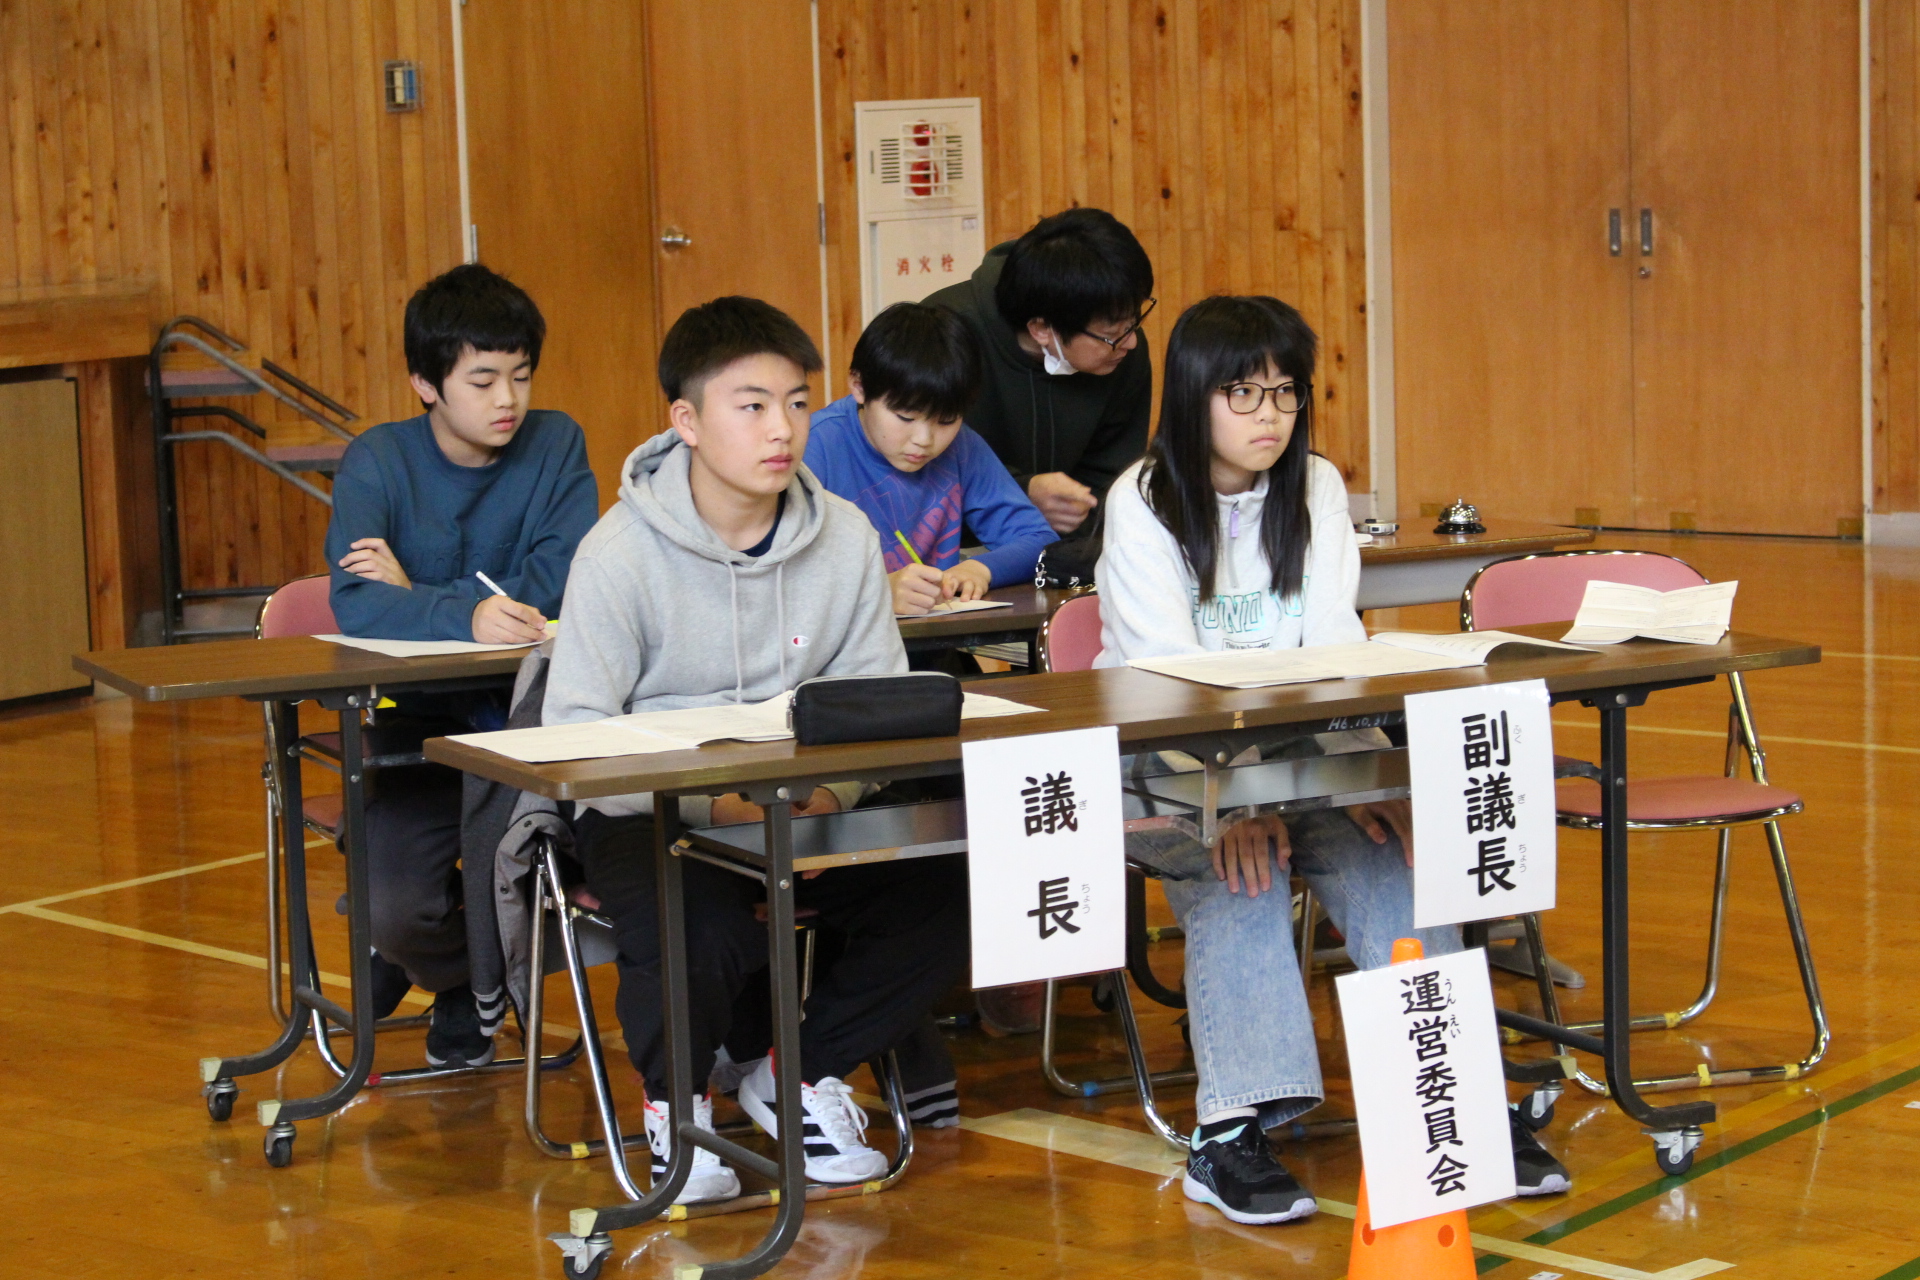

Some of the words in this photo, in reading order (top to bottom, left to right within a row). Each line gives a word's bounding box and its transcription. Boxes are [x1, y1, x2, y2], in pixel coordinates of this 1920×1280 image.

[896, 253, 954, 276] 消火栓
[1462, 710, 1517, 897] 副議長
[1400, 970, 1469, 1197] 運営委員会
